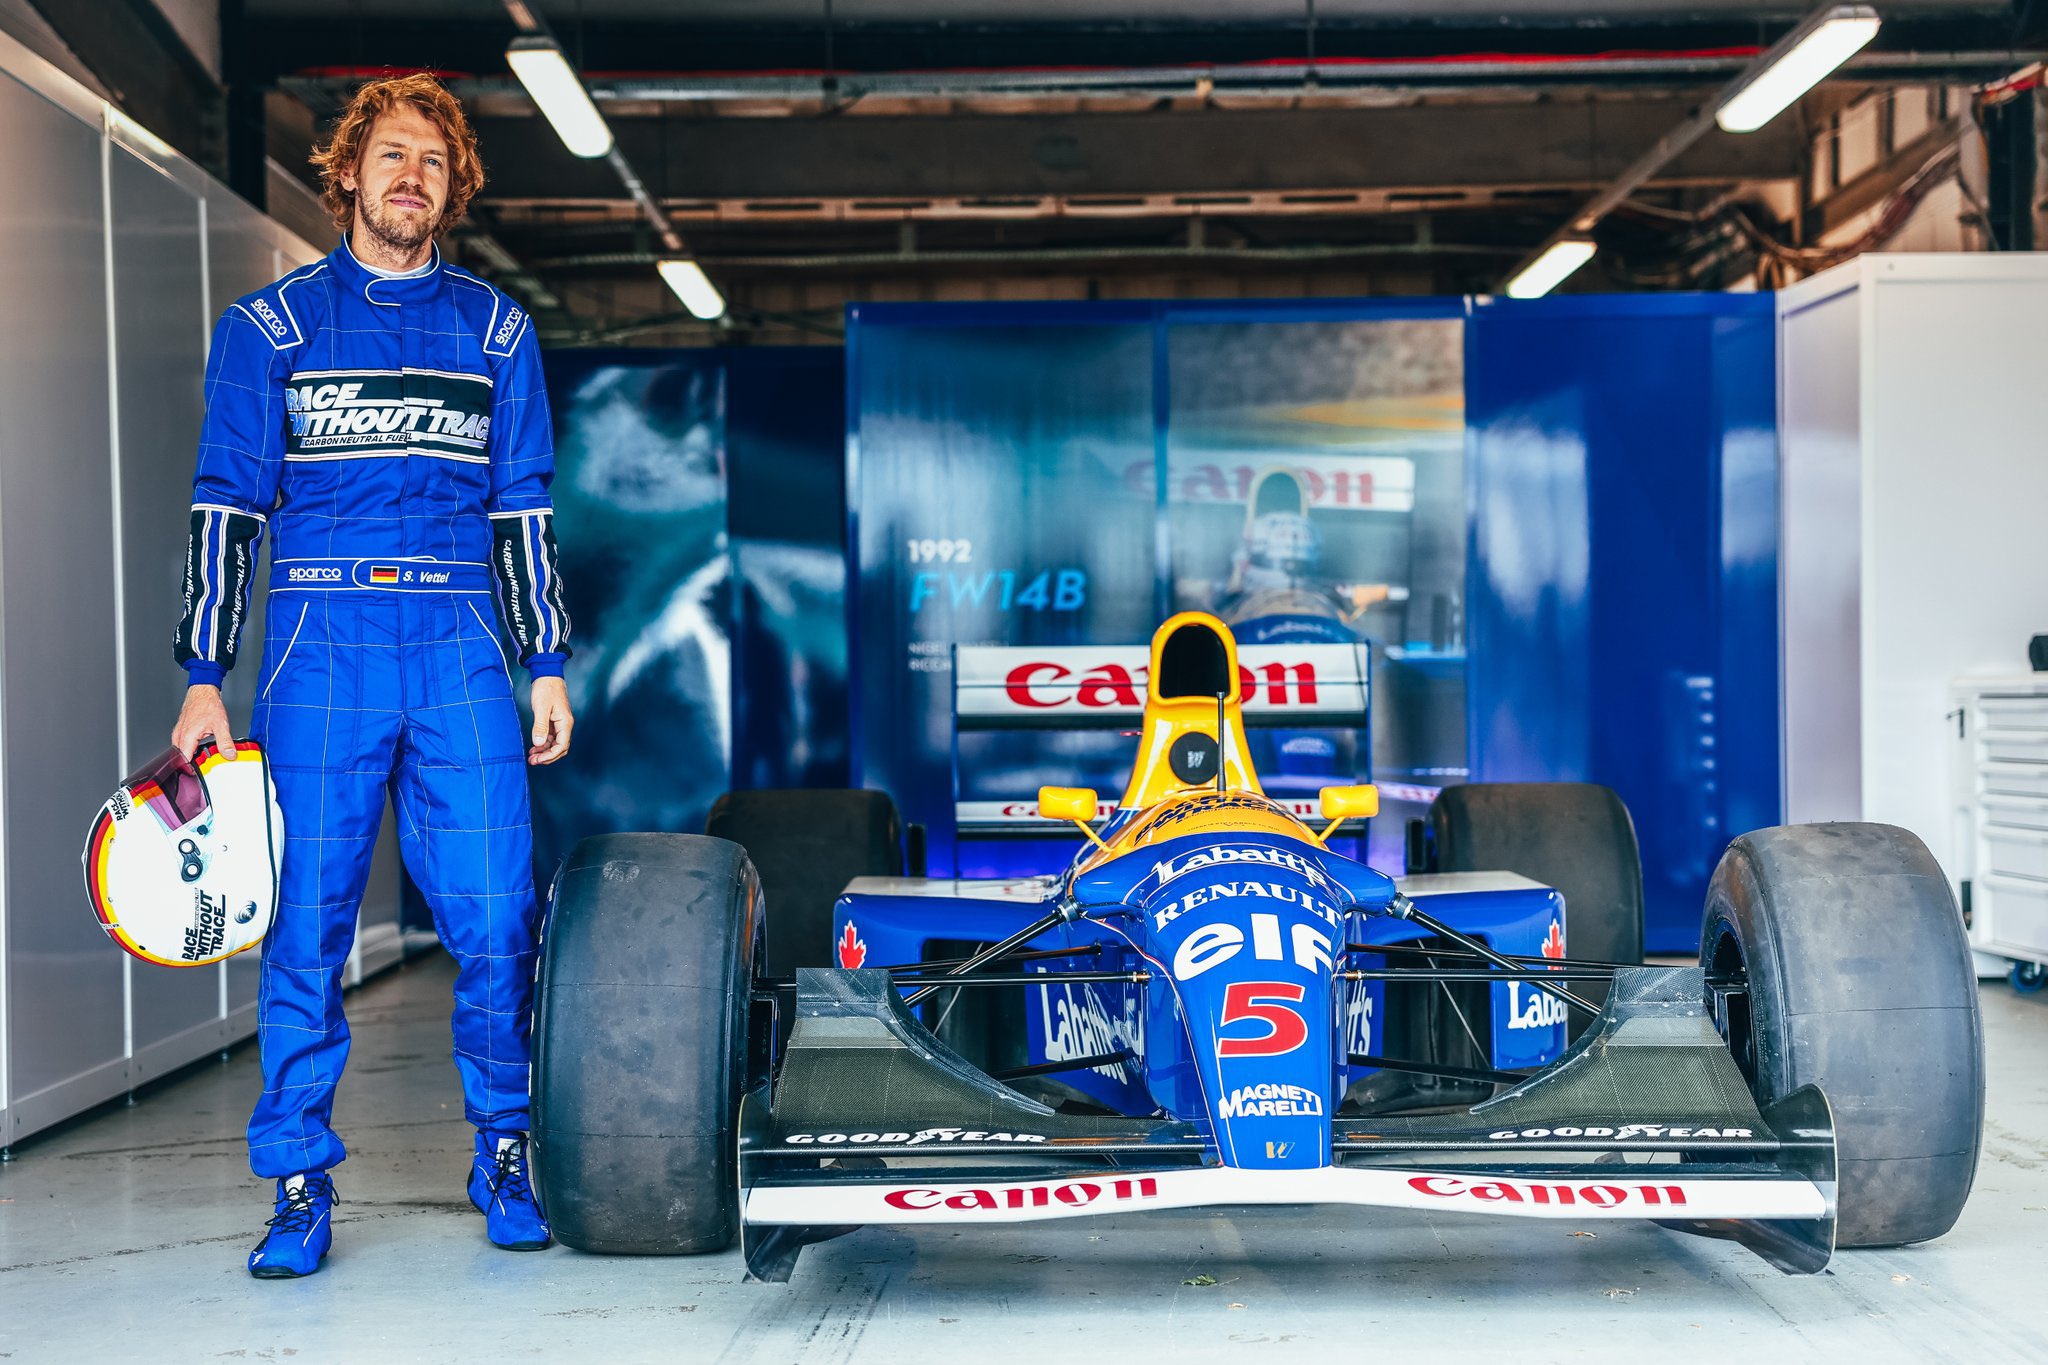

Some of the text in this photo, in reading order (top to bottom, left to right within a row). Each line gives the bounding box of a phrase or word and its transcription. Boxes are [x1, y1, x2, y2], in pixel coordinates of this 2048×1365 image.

[250, 298, 288, 338] sparco
[495, 307, 522, 347] sparco
[285, 383, 363, 411] RACE
[288, 406, 491, 441] WITHOUT TRAC
[304, 437, 340, 447] CARBON
[340, 434, 384, 445] NEUTRAL
[908, 538, 973, 564] 1992
[289, 567, 342, 582] sparco
[402, 571, 451, 583] S. Vettel
[502, 539, 528, 647] CARBON NEUTRAL FUEL
[909, 567, 1087, 613] FW14B
[226, 543, 246, 654] CARBON NEUTRAL FUEL
[1005, 662, 1318, 707] Can
[195, 889, 213, 961] WITHOUT
[209, 894, 226, 955] TRACE
[1153, 881, 1342, 933] RENAULT
[181, 927, 198, 960] RACE
[1173, 913, 1332, 981] elf
[1218, 981, 1308, 1058] 5
[884, 1178, 1157, 1210] Canon
[1407, 1176, 1687, 1208] Canon
